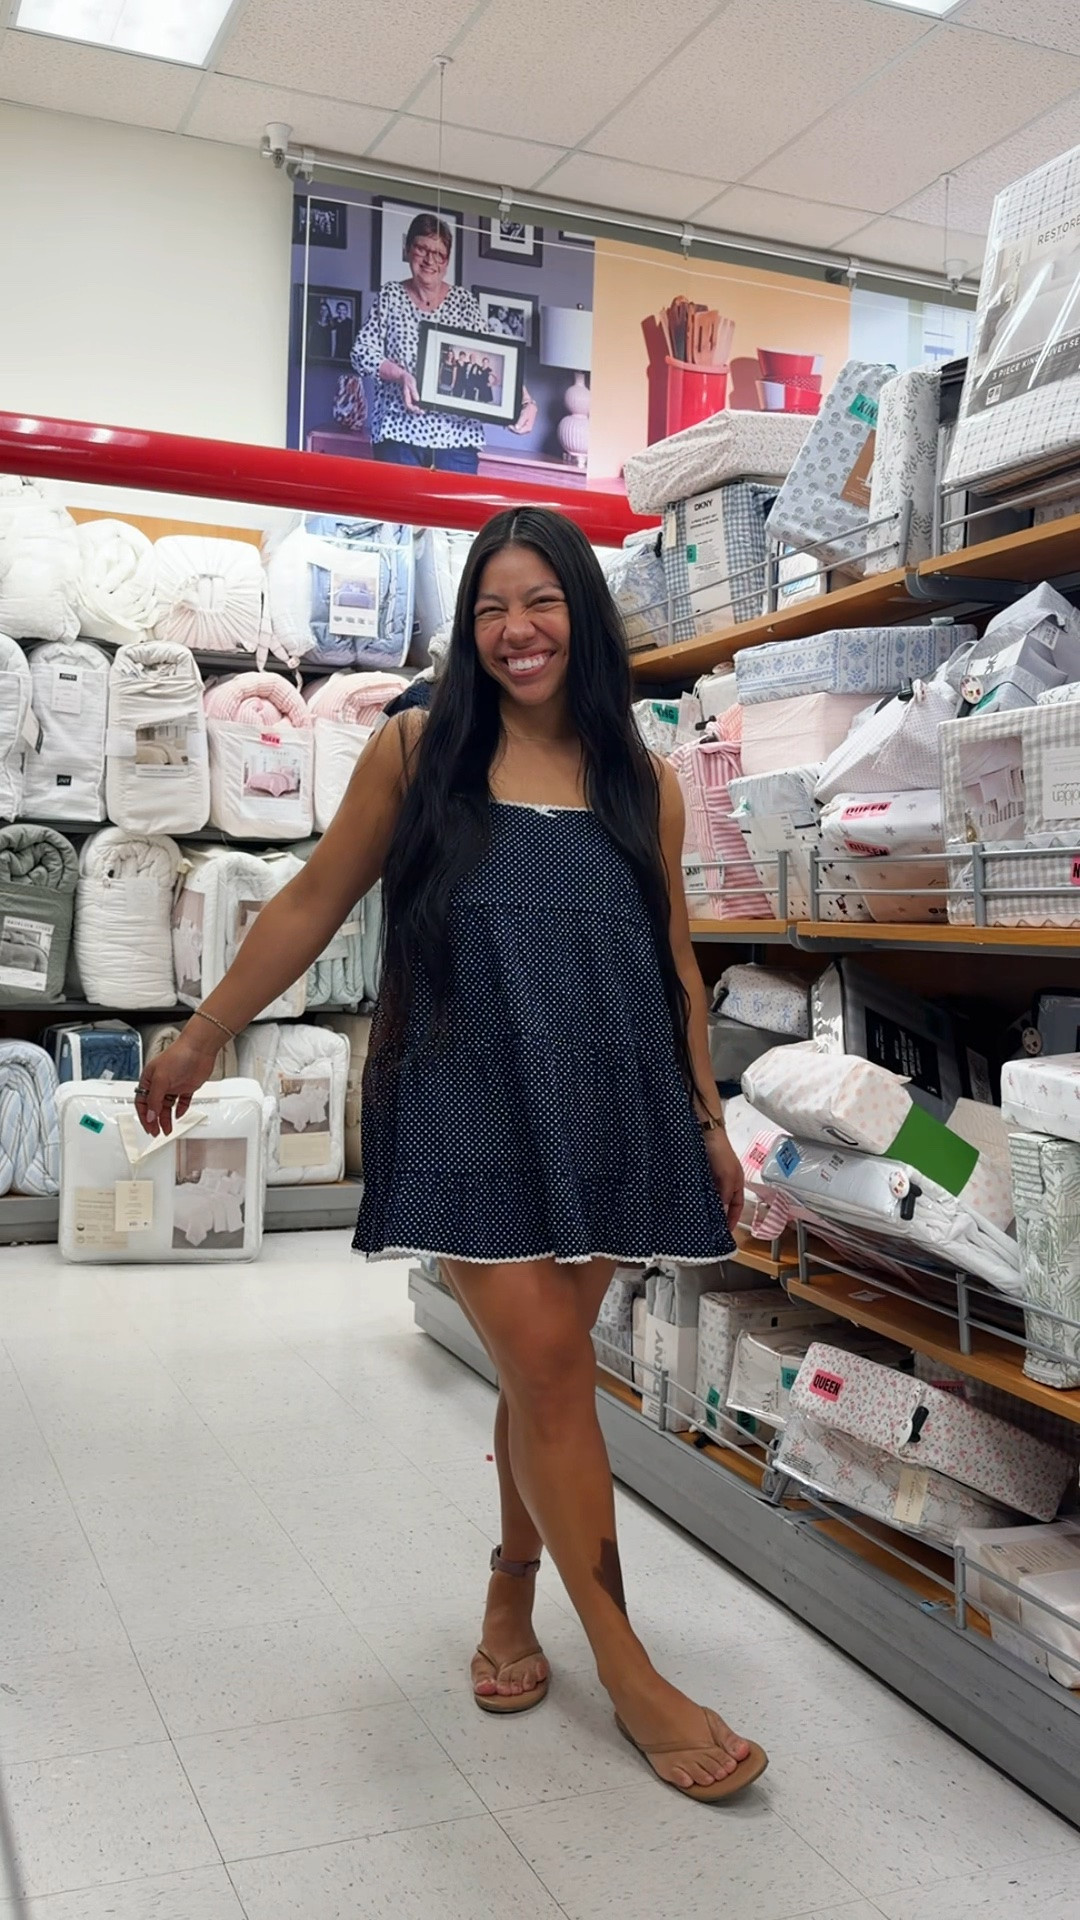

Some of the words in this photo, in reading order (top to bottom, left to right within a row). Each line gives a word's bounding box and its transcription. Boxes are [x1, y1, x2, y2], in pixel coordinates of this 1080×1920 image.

[998, 361, 1021, 378] PIECE
[856, 401, 879, 419] KIN
[694, 499, 714, 511] DKNY
[813, 1373, 842, 1397] QUEEN
